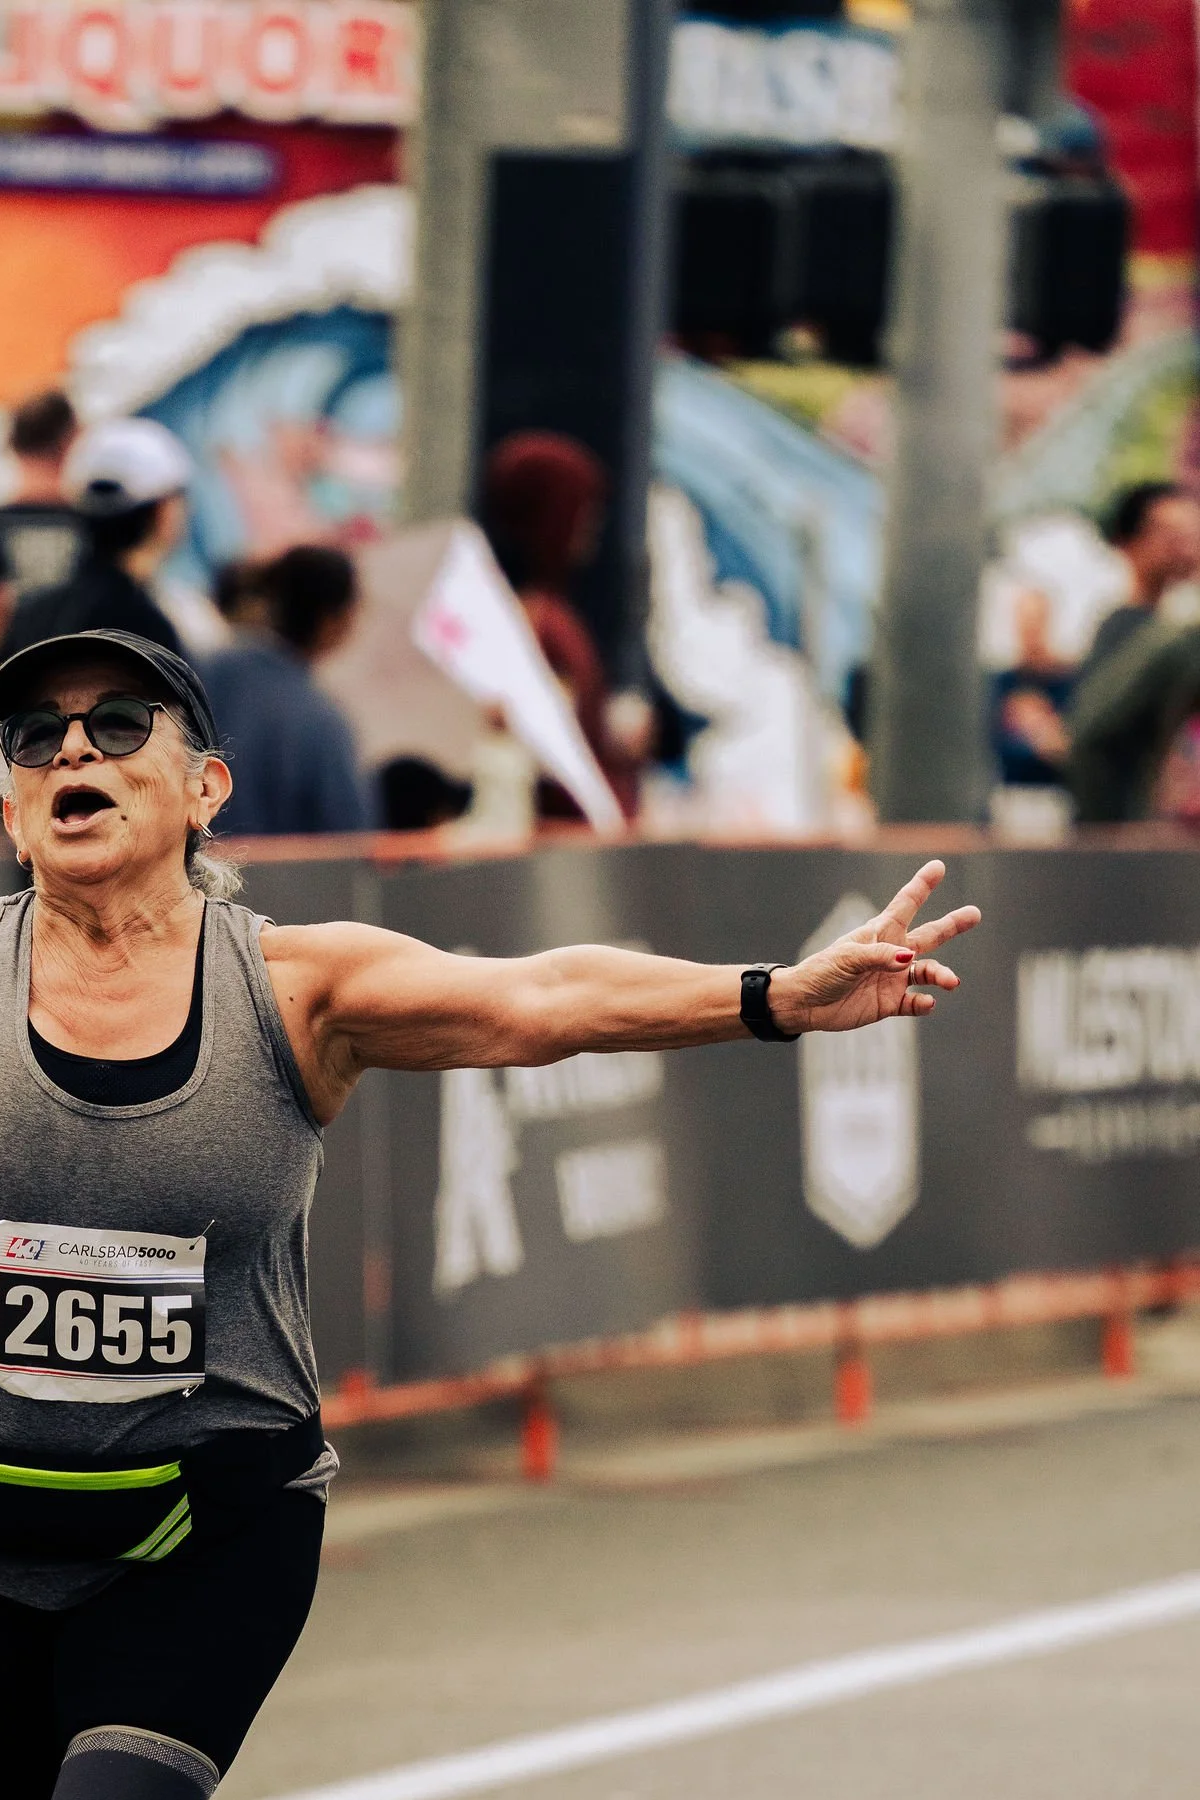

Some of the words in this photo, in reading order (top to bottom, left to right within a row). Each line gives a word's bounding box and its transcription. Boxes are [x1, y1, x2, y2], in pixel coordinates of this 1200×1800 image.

[58, 1242, 176, 1261] CARLSBAD5000
[94, 1259, 118, 1268] YEARS
[135, 1260, 153, 1268] FAST
[4, 1285, 193, 1365] 2655
